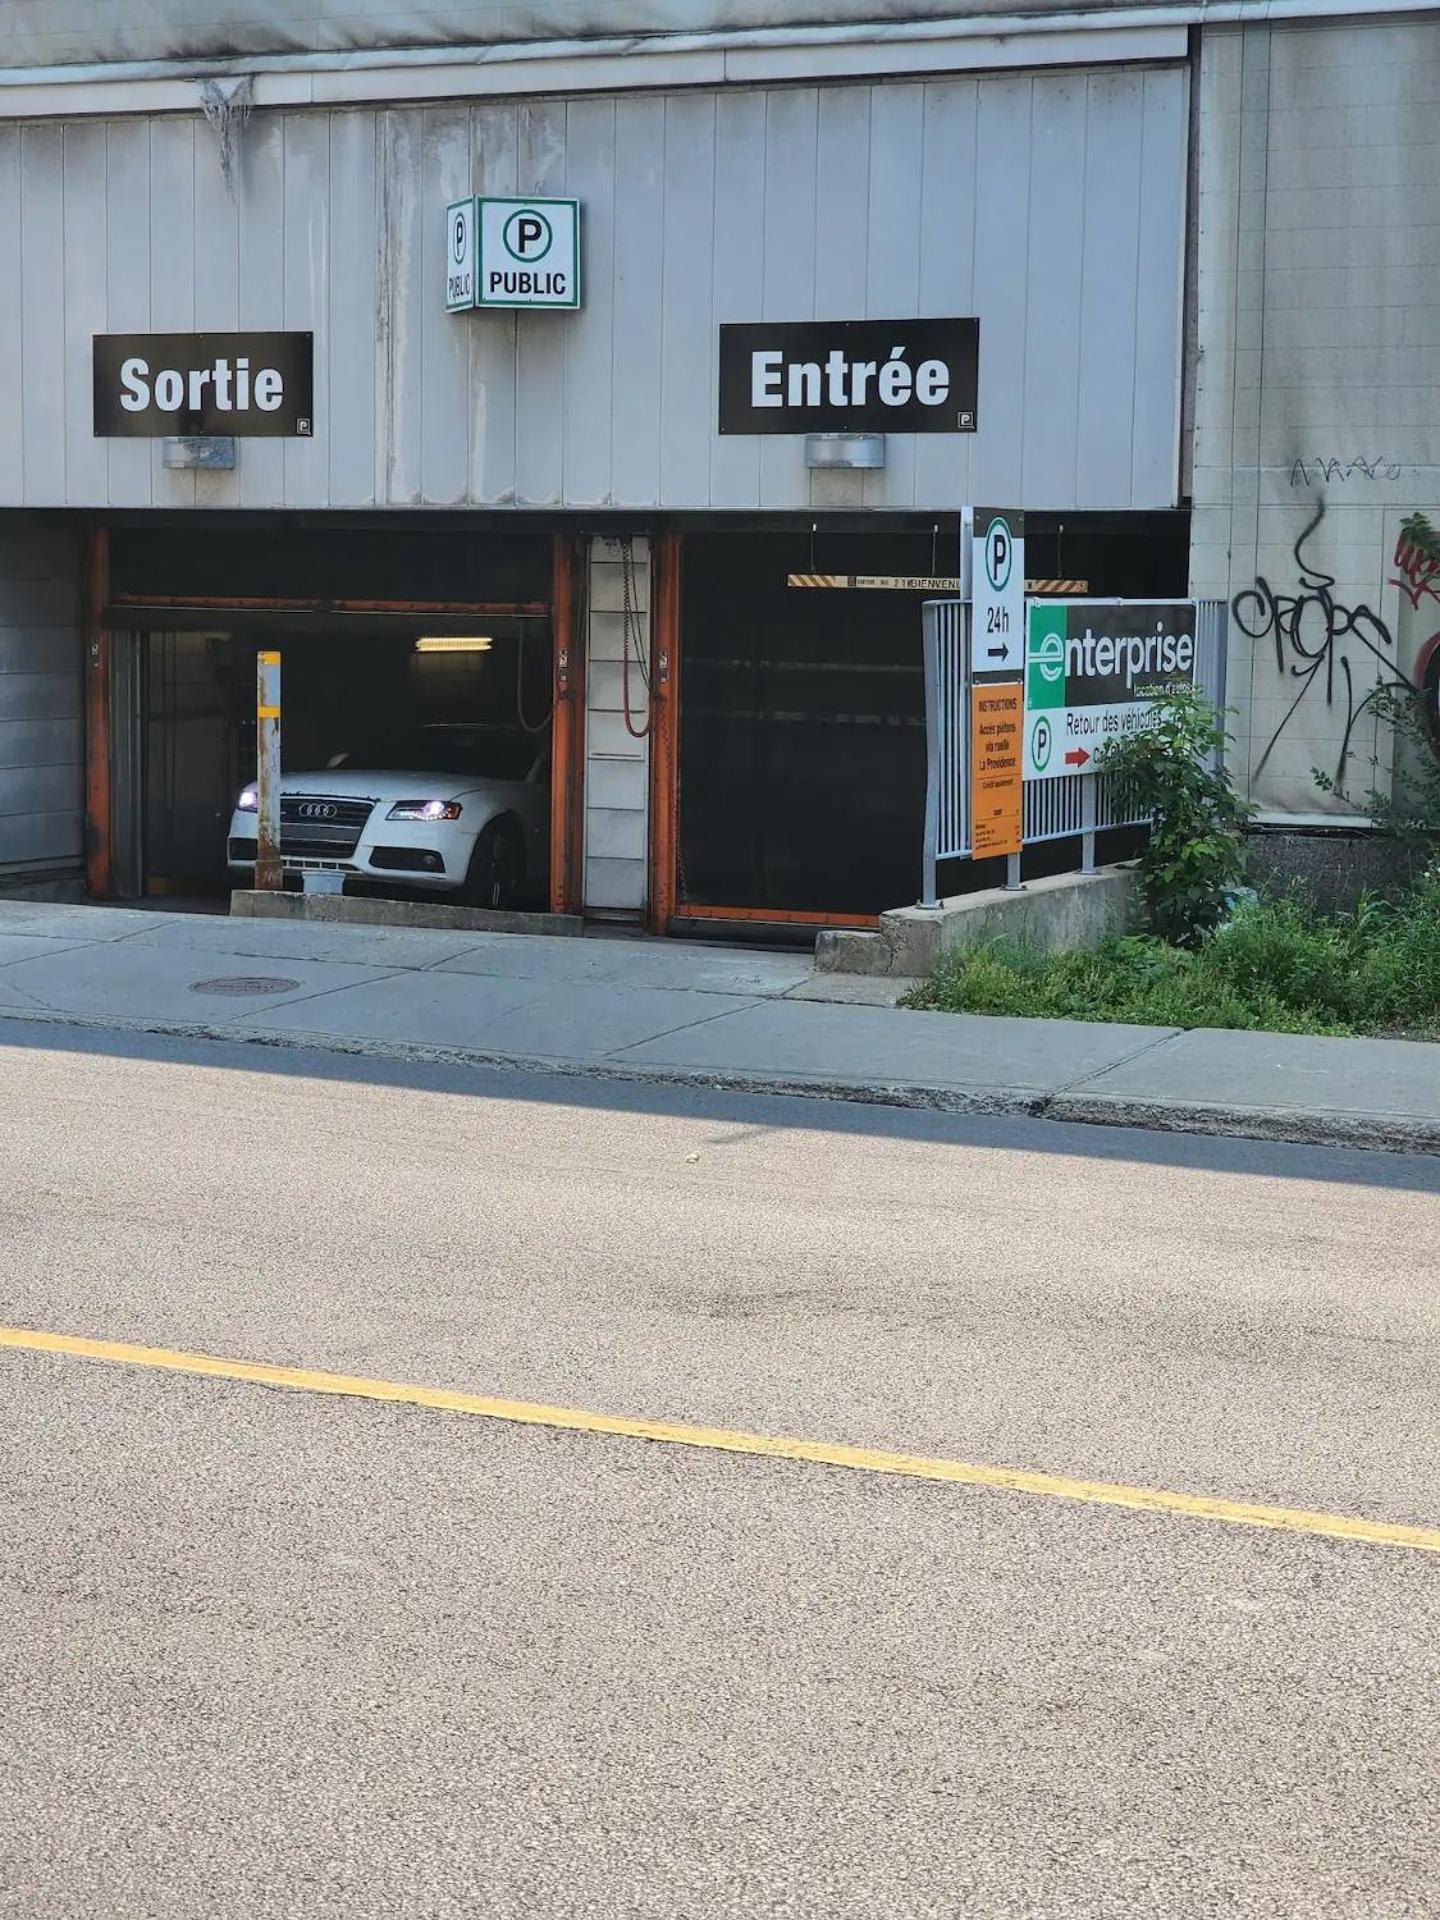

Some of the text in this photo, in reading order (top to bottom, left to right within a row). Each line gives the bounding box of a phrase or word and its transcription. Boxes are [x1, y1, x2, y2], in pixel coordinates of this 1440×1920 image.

[455, 221, 463, 256] P
[518, 218, 542, 254] P
[448, 273, 471, 298] PUBLIC
[489, 271, 567, 295] PUBLIC
[120, 357, 284, 412] Sortie
[751, 346, 950, 407] Entrée
[993, 534, 1007, 581] P
[911, 579, 959, 590] BIENVEN
[987, 606, 1010, 633] 24h
[1030, 620, 1194, 689] enterprise
[978, 697, 1017, 713] INSTRUCTIONS
[1066, 712, 1100, 736] Retour
[1102, 709, 1119, 732] des
[985, 742, 993, 752] via
[1038, 728, 1047, 760] P
